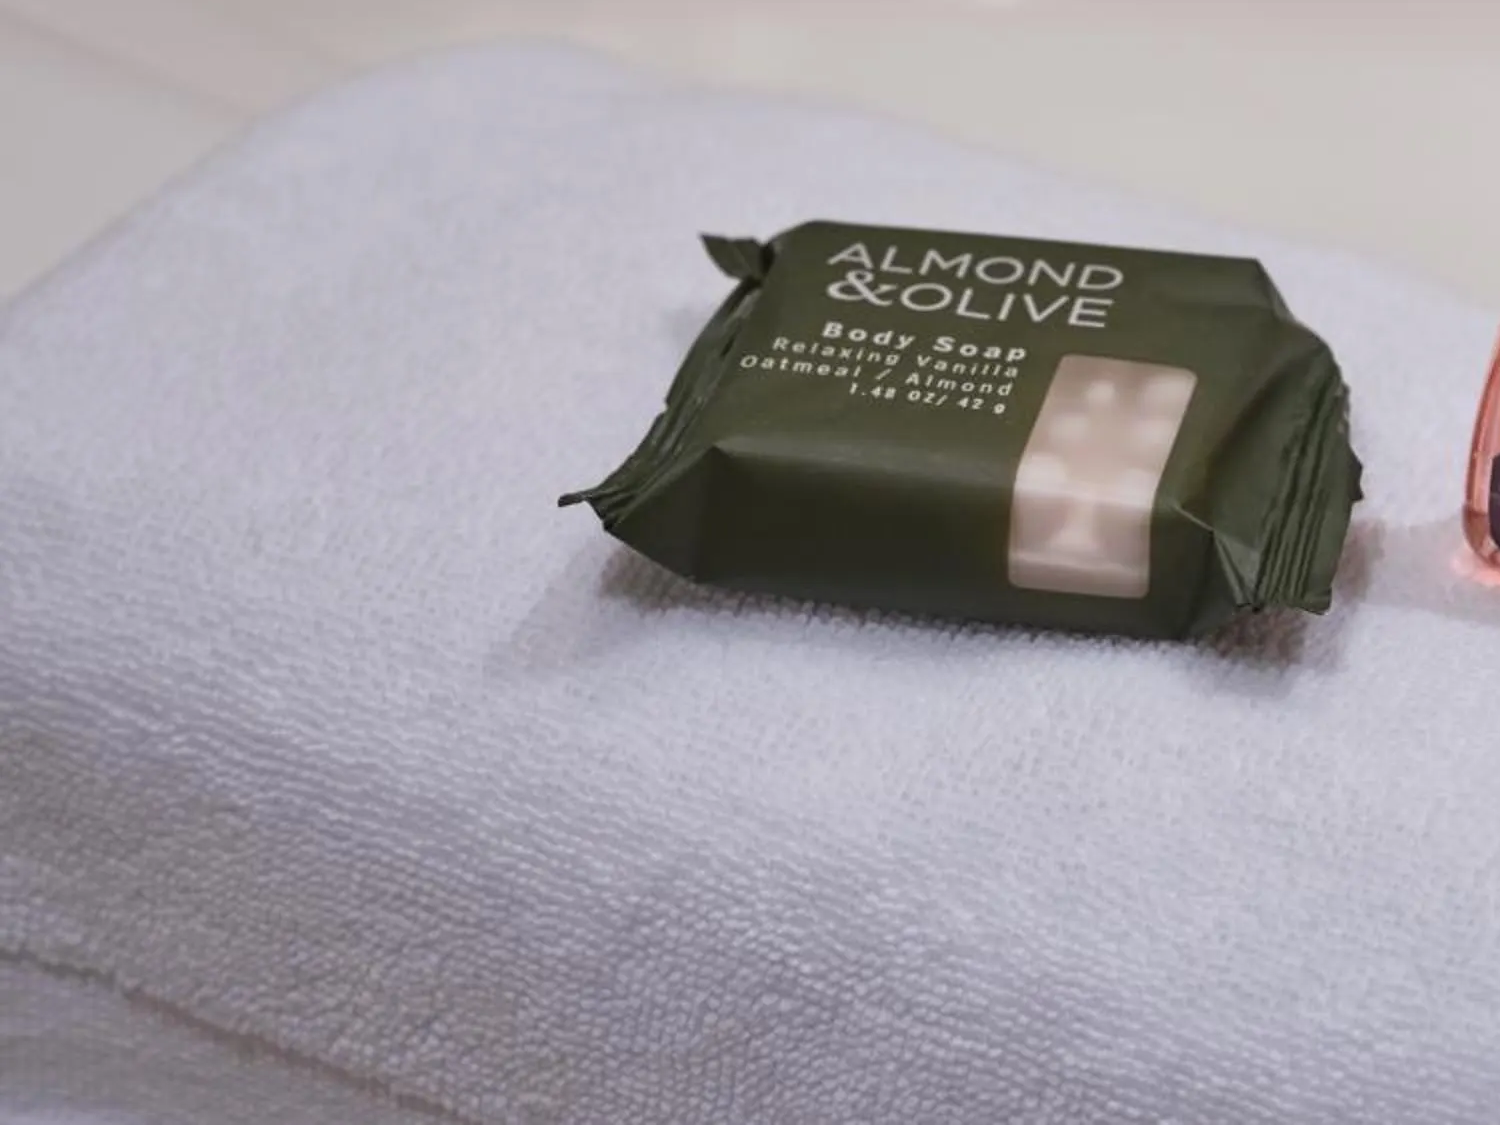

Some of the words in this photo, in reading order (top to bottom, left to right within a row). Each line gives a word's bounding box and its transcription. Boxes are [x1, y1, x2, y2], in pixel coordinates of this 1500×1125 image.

[827, 242, 1125, 291] ALMOND
[826, 269, 1114, 329] &OLIVE
[772, 336, 900, 366] Relaxing
[822, 321, 916, 350] Body
[932, 335, 1027, 363] Soap
[740, 355, 861, 378] Oatmeal
[905, 372, 1014, 397] Almond
